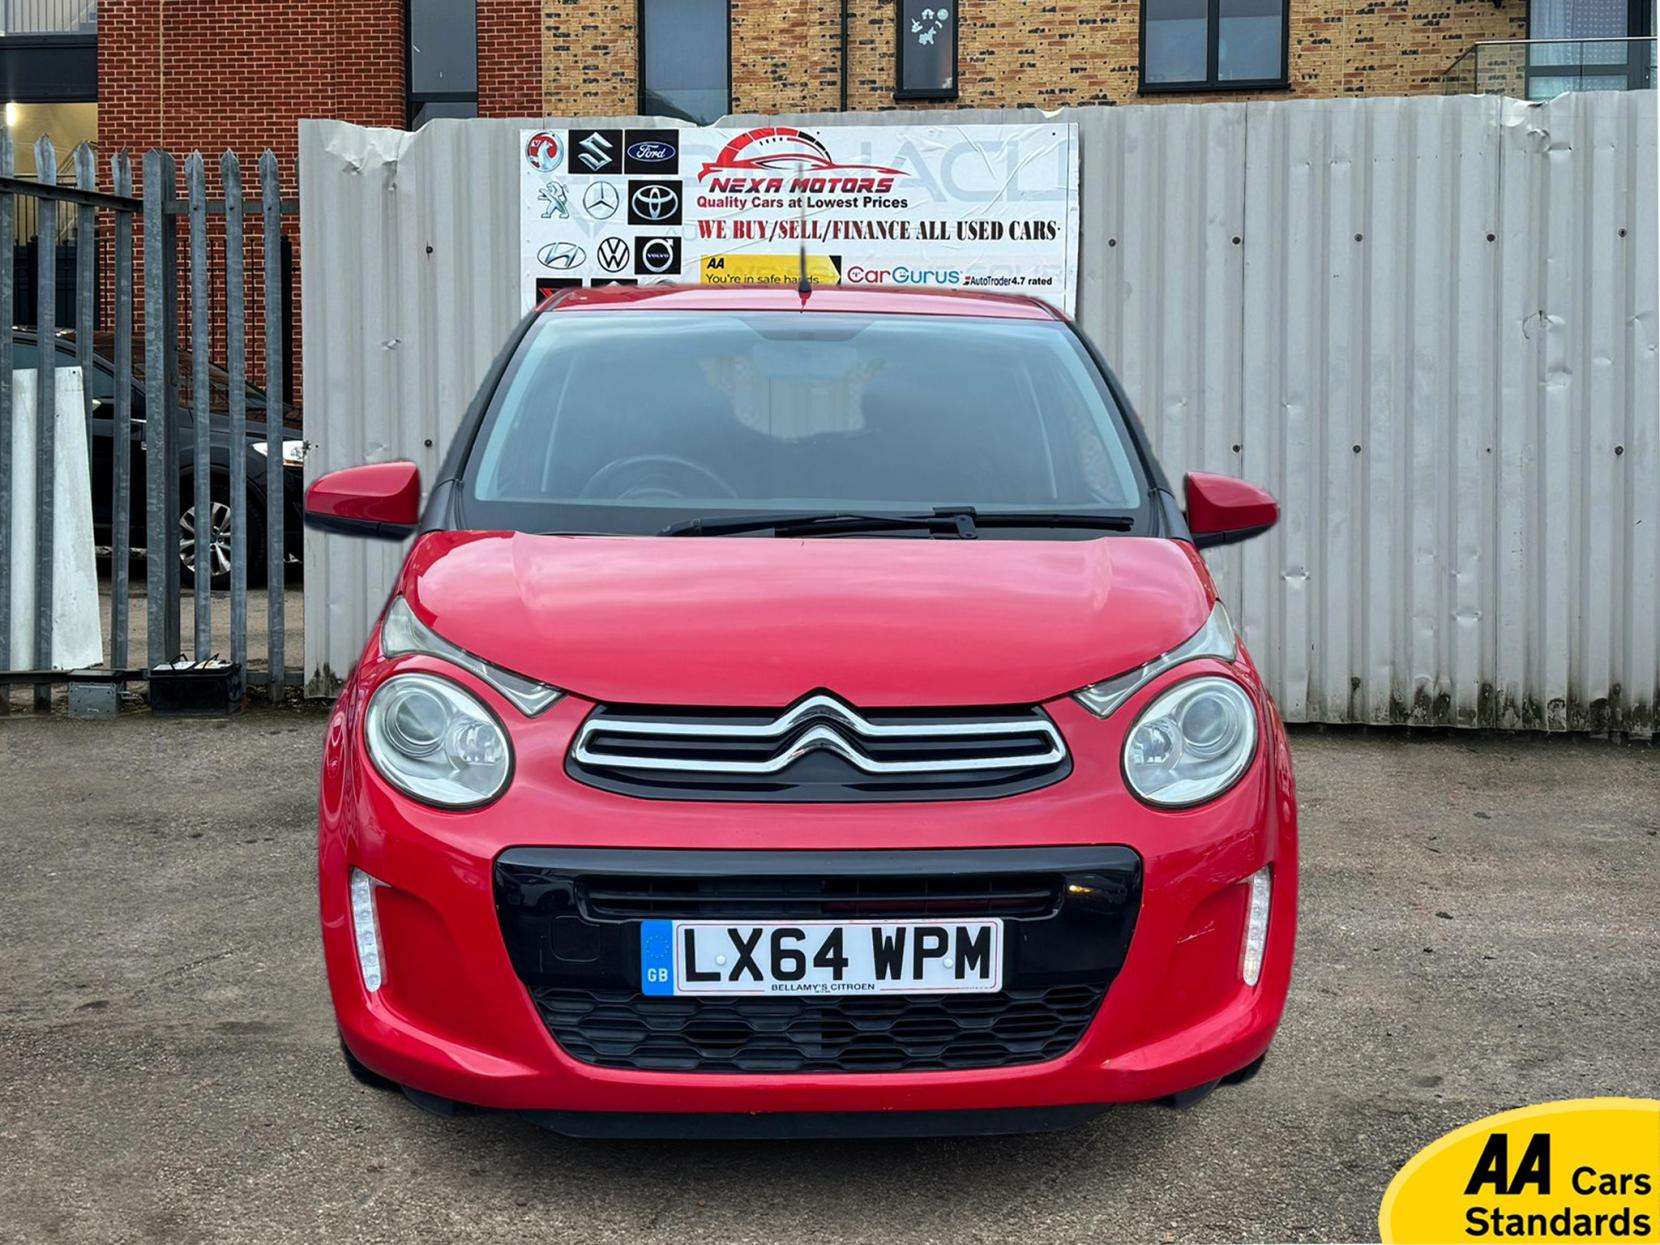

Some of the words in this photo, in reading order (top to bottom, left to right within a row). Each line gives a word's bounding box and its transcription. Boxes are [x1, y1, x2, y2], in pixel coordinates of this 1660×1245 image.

[635, 143, 666, 158] Ford
[709, 177, 784, 193] NEXA
[789, 178, 895, 194] MOTORS
[697, 196, 747, 210] Quality
[752, 196, 784, 208] Cars
[788, 197, 802, 208] at
[807, 197, 859, 209] Lowest
[863, 197, 909, 209] Prices
[697, 219, 727, 239] WE
[915, 220, 951, 240] ALL
[956, 220, 1004, 240] USED
[707, 258, 724, 269] AA
[706, 274, 740, 284] You're
[744, 274, 754, 284] in
[757, 274, 781, 284] safe
[847, 266, 960, 283] CarGurus
[1028, 278, 1053, 286] rated
[684, 927, 849, 982] LX64
[872, 926, 991, 981] WPM
[648, 968, 668, 982] GB
